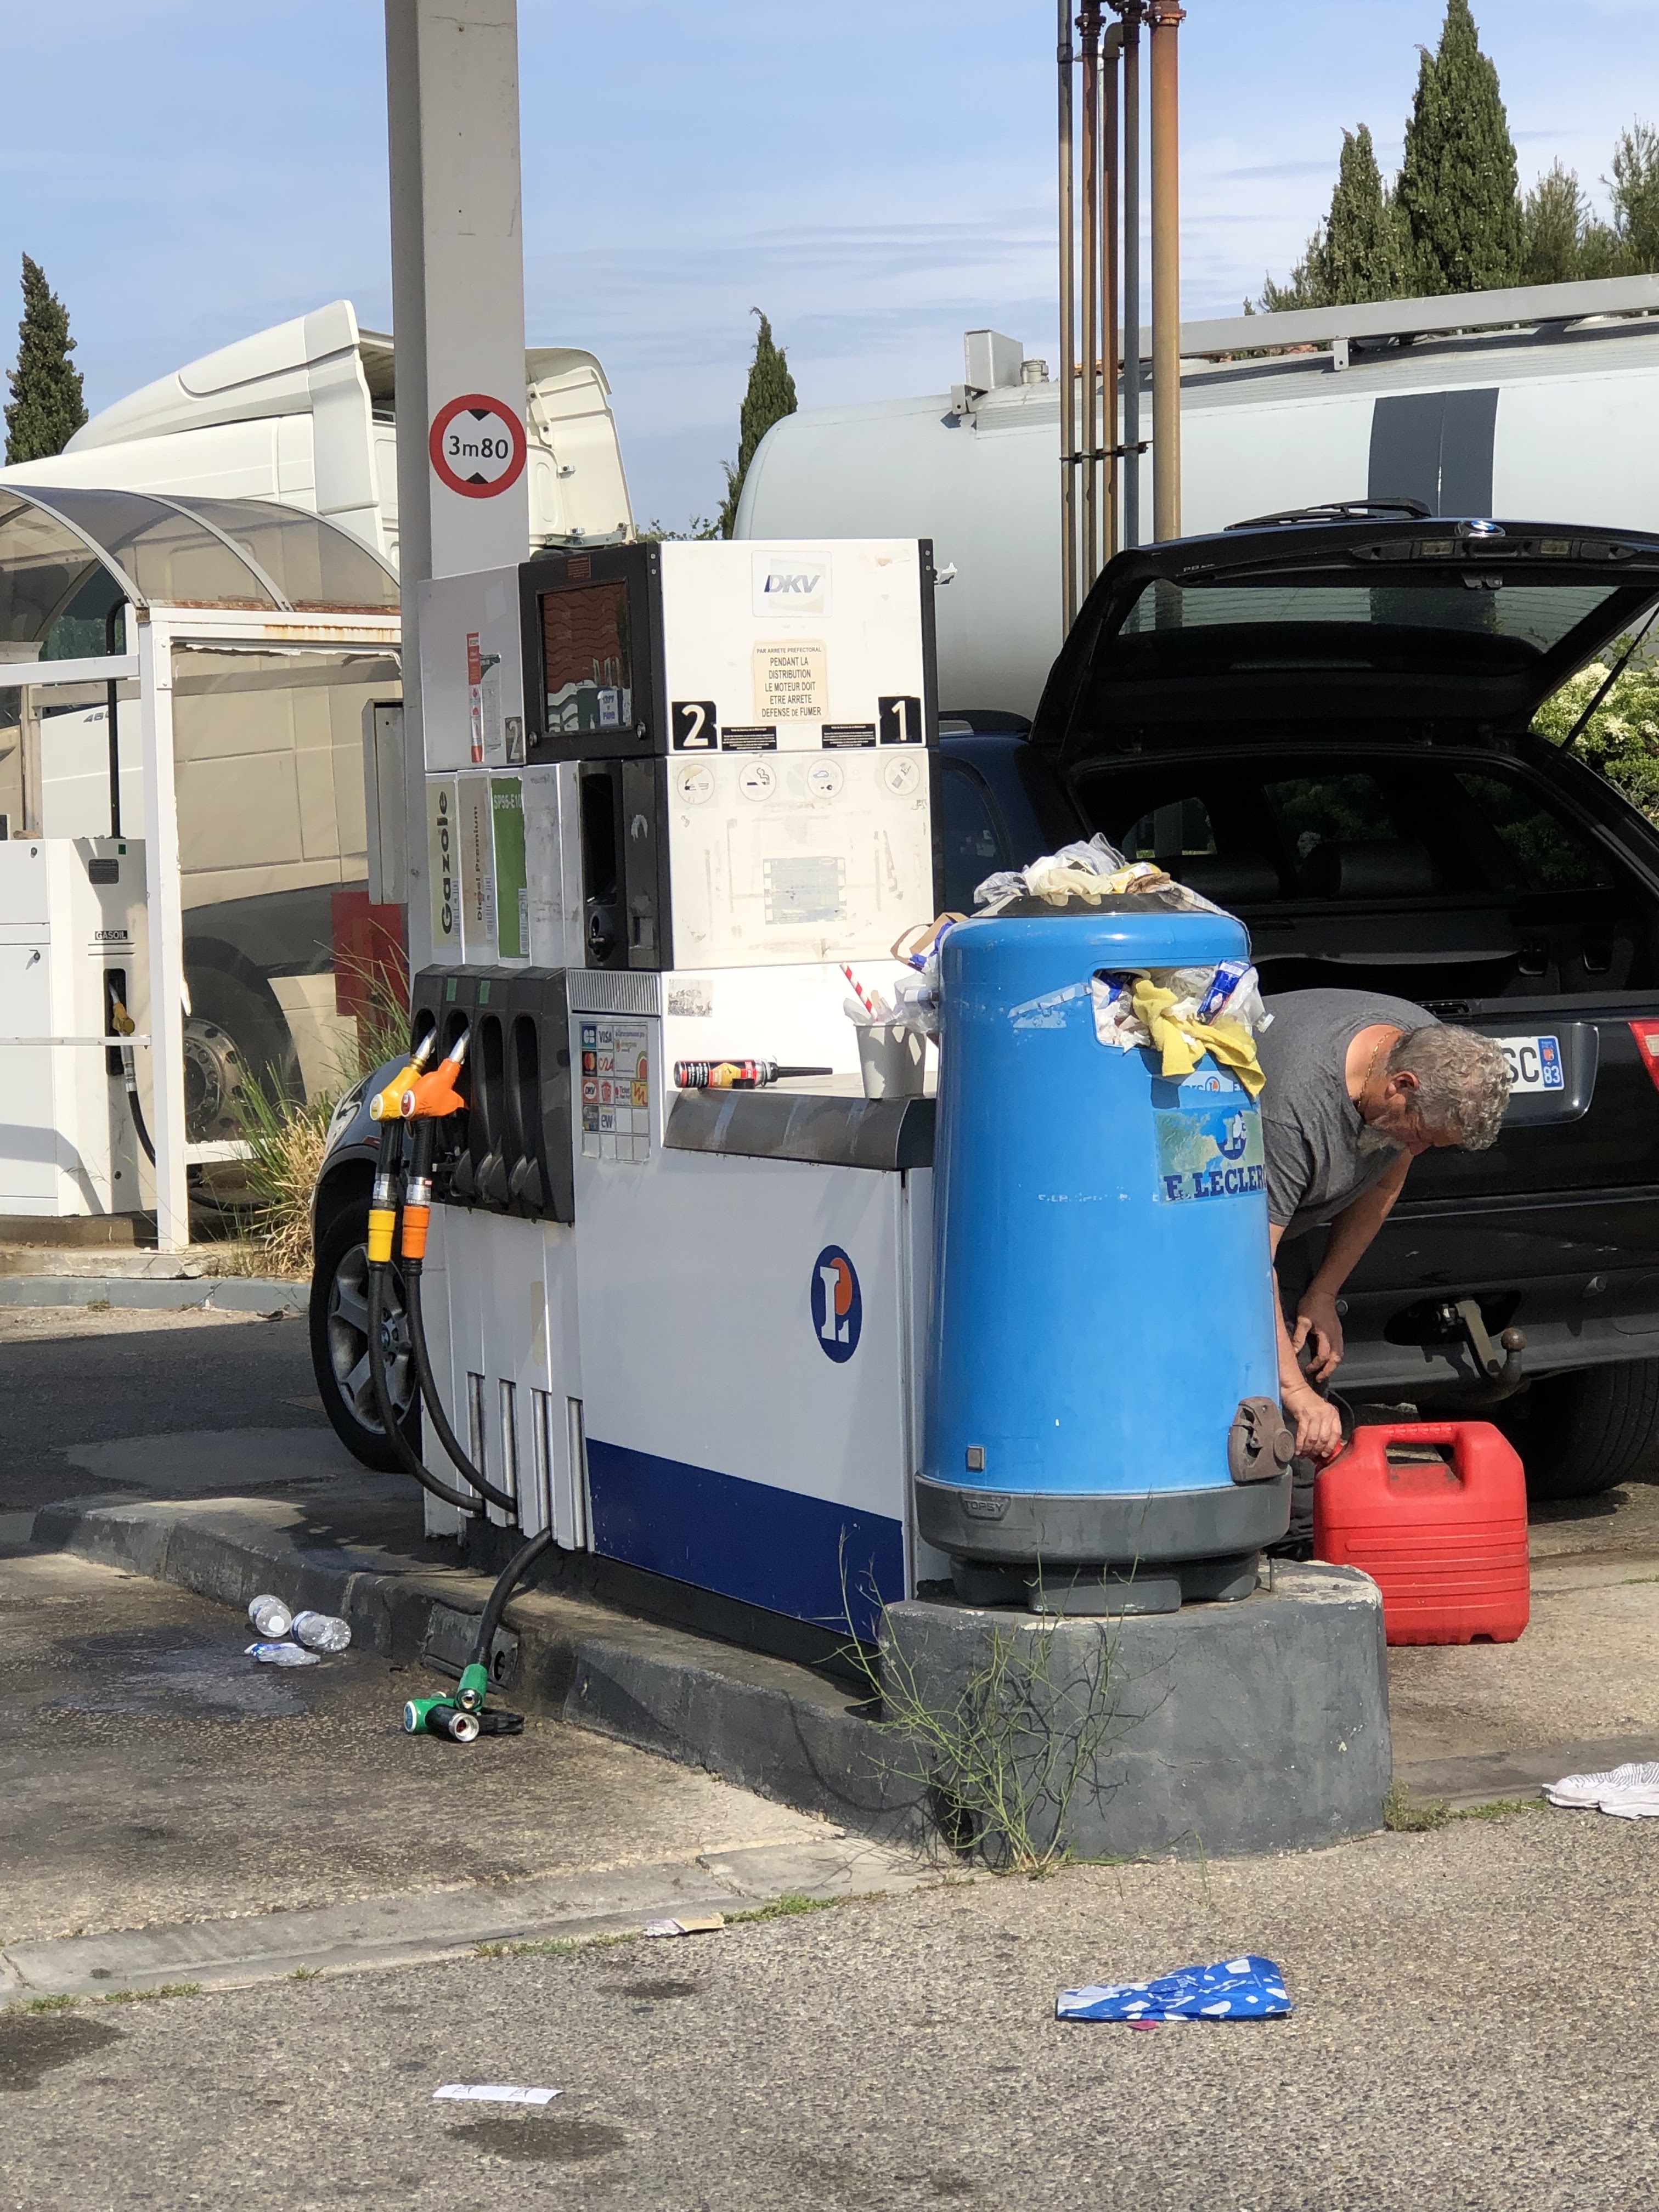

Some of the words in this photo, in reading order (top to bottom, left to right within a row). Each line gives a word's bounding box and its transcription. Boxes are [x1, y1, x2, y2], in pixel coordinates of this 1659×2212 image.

[449, 436, 509, 459] 3m80
[764, 574, 821, 593] DKV
[770, 657, 799, 666] PENDANT
[800, 657, 809, 665] LA
[769, 669, 811, 679] DISTRIBUTION
[765, 682, 773, 692] LE
[774, 682, 800, 692] MOTEUR
[802, 681, 816, 691] DOIT
[770, 695, 786, 704] ETRE
[787, 695, 812, 704] ARRETE
[761, 708, 790, 717] DEFENSE
[800, 707, 822, 716] FUMER
[681, 704, 708, 747] 2
[891, 700, 907, 741] 1
[509, 720, 520, 760] 2
[437, 792, 452, 934] Gazole
[96, 931, 126, 940] GASOIL
[599, 1031, 612, 1043] VISA
[1544, 1065, 1560, 1084] 83
[964, 1499, 1003, 1511] TOPSY
